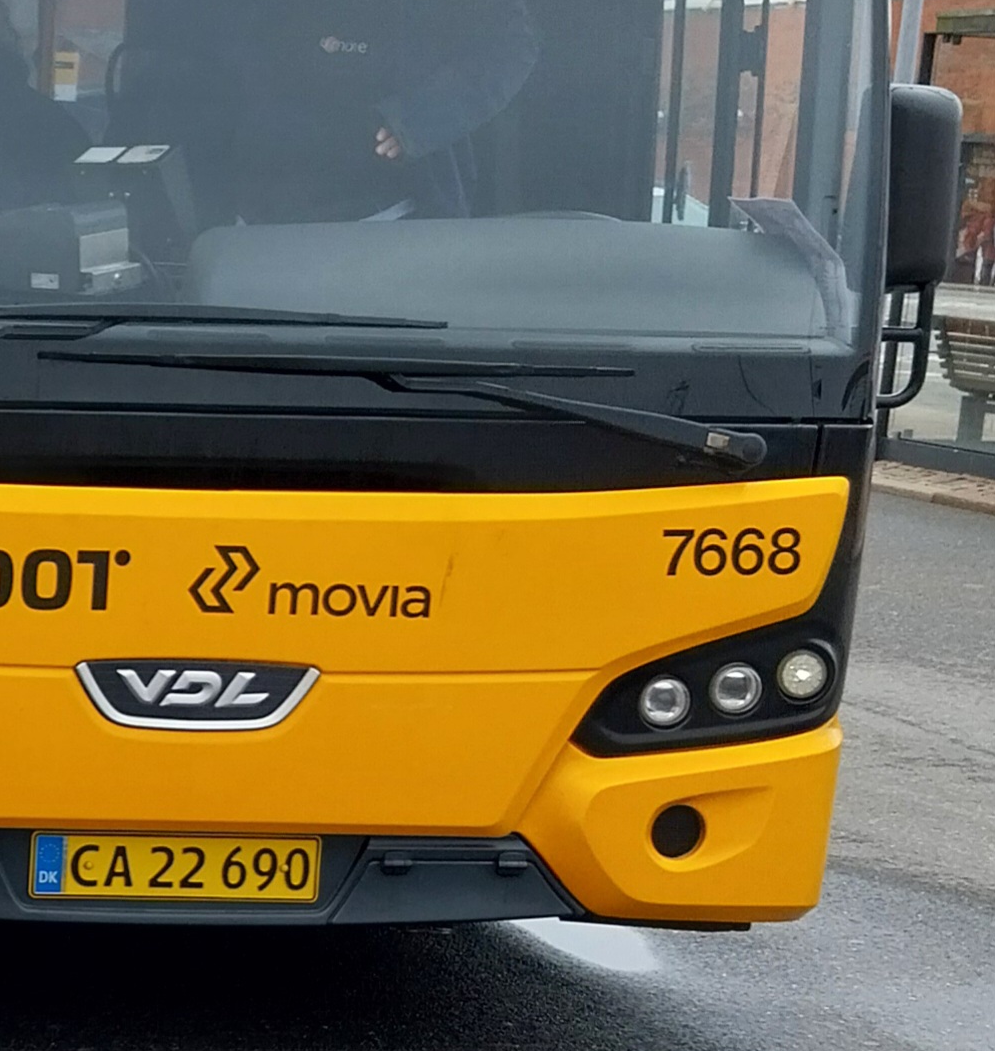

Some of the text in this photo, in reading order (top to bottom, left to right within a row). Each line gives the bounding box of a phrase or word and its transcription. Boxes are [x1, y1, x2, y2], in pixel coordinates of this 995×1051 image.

[664, 528, 800, 575] 7668
[269, 583, 430, 617] movia
[116, 668, 270, 707] VDL
[38, 871, 57, 885] DK
[71, 844, 310, 891] CA 22 690
